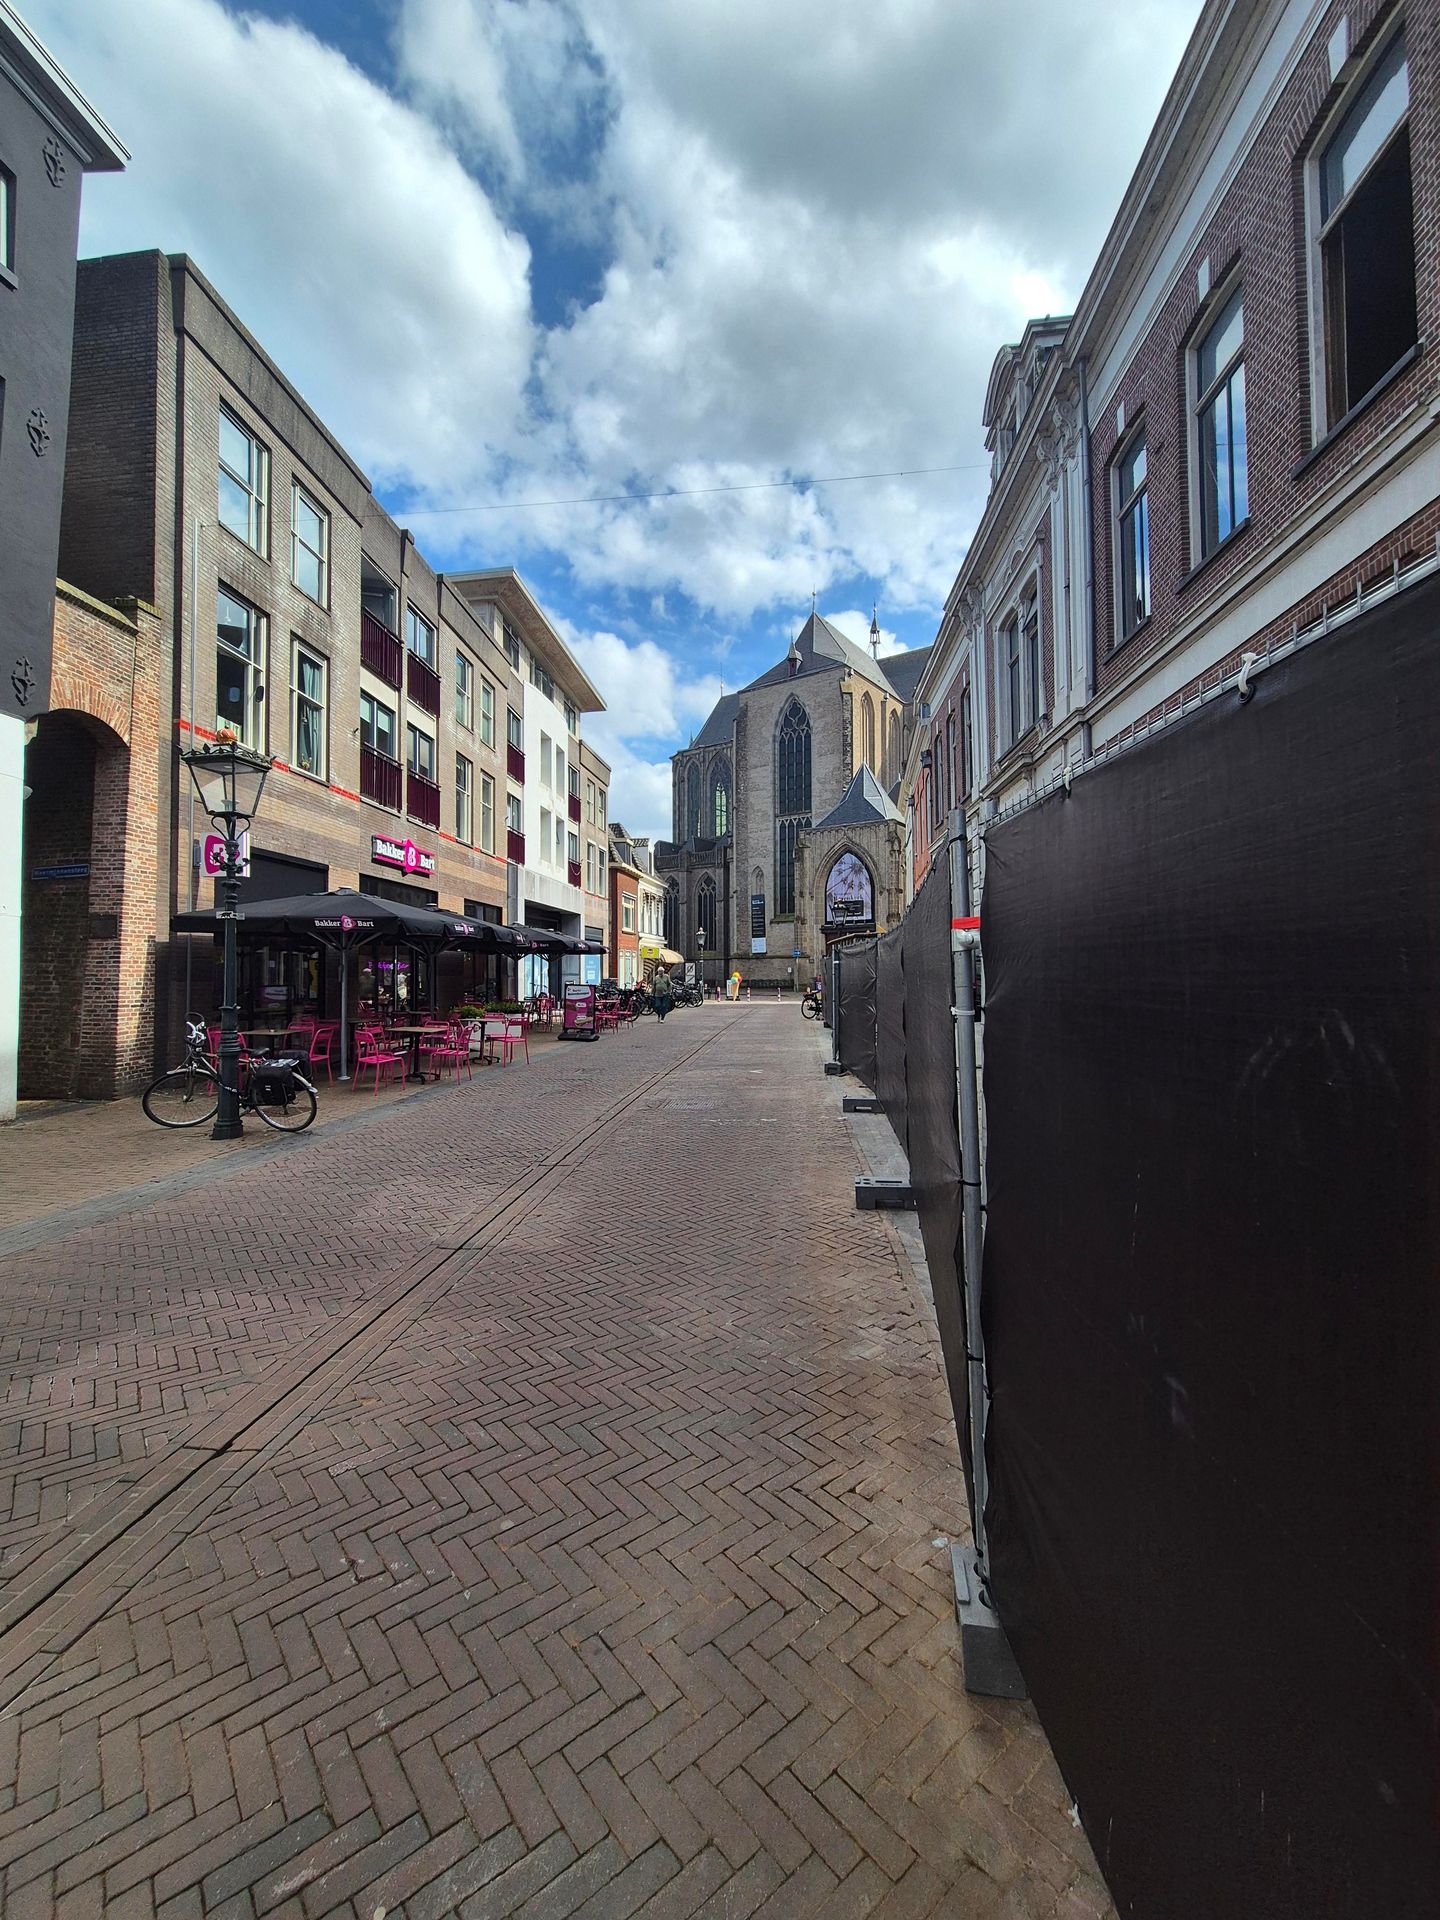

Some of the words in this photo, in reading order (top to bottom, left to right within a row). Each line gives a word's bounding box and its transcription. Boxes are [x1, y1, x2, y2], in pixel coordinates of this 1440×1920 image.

[376, 839, 405, 861] Bakker
[420, 854, 435, 870] Bart
[314, 919, 341, 927] Bakker
